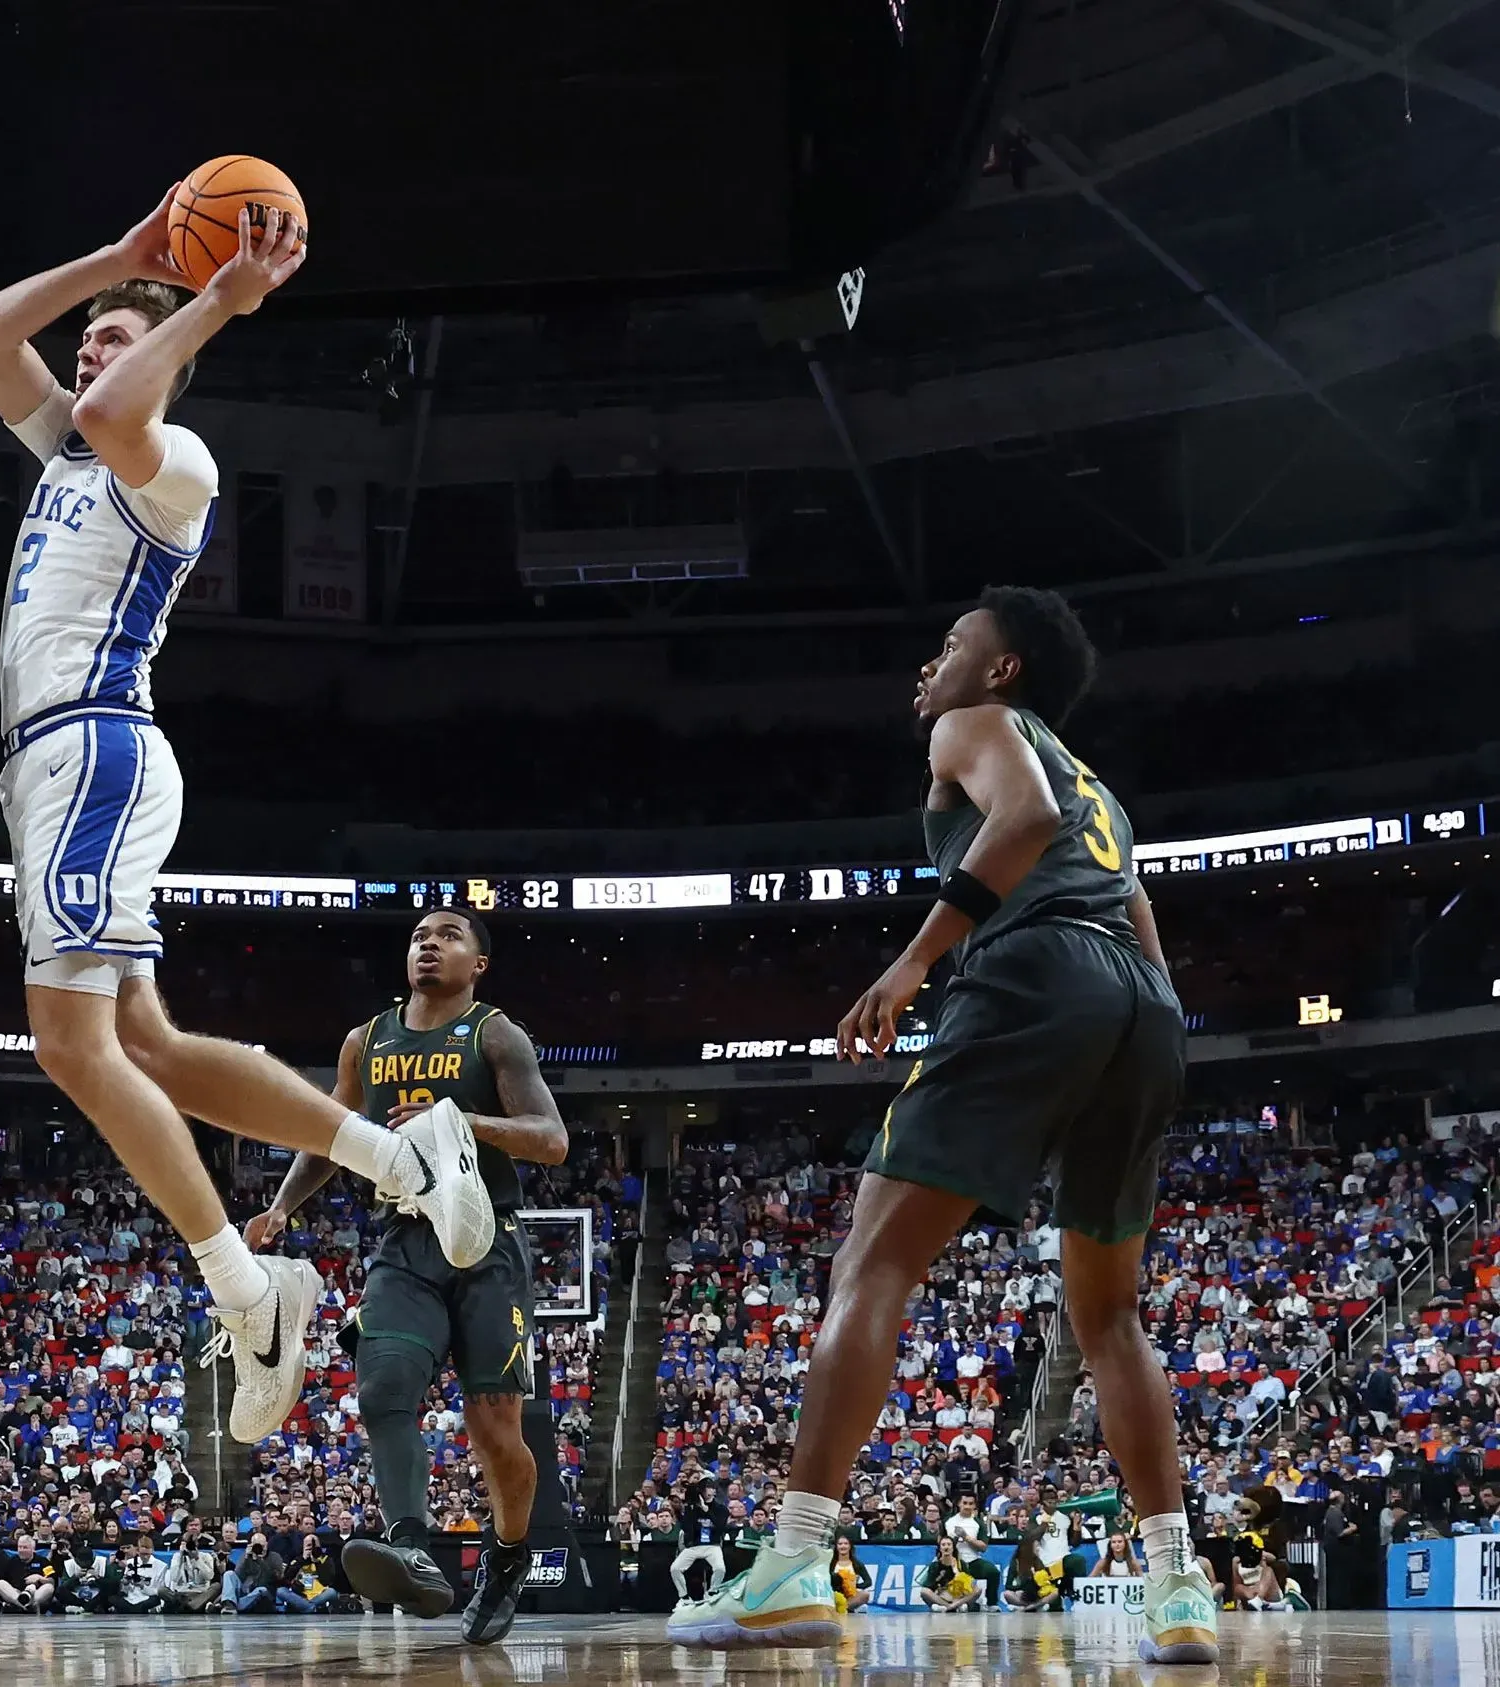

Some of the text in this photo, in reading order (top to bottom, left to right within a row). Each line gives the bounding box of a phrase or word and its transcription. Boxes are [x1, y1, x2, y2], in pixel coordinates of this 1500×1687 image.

[11, 533, 47, 605] 2
[1253, 847, 1263, 863] 1
[1169, 857, 1180, 872] 2
[883, 868, 901, 879] FLS
[3, 879, 13, 894] 2
[60, 874, 97, 905] D
[364, 883, 396, 893] BONUS
[410, 883, 427, 893] FLS
[439, 883, 456, 893] TOL
[749, 873, 786, 902] 47
[808, 868, 844, 900] D
[162, 888, 172, 903] 2
[243, 890, 251, 905] 1
[321, 893, 332, 908] 3
[442, 894, 452, 907] 2
[522, 880, 559, 909] 32
[588, 882, 657, 904] 19:31
[413, 894, 423, 908] 0
[726, 1041, 787, 1058] FIRST
[371, 1053, 462, 1085] BAYLOR
